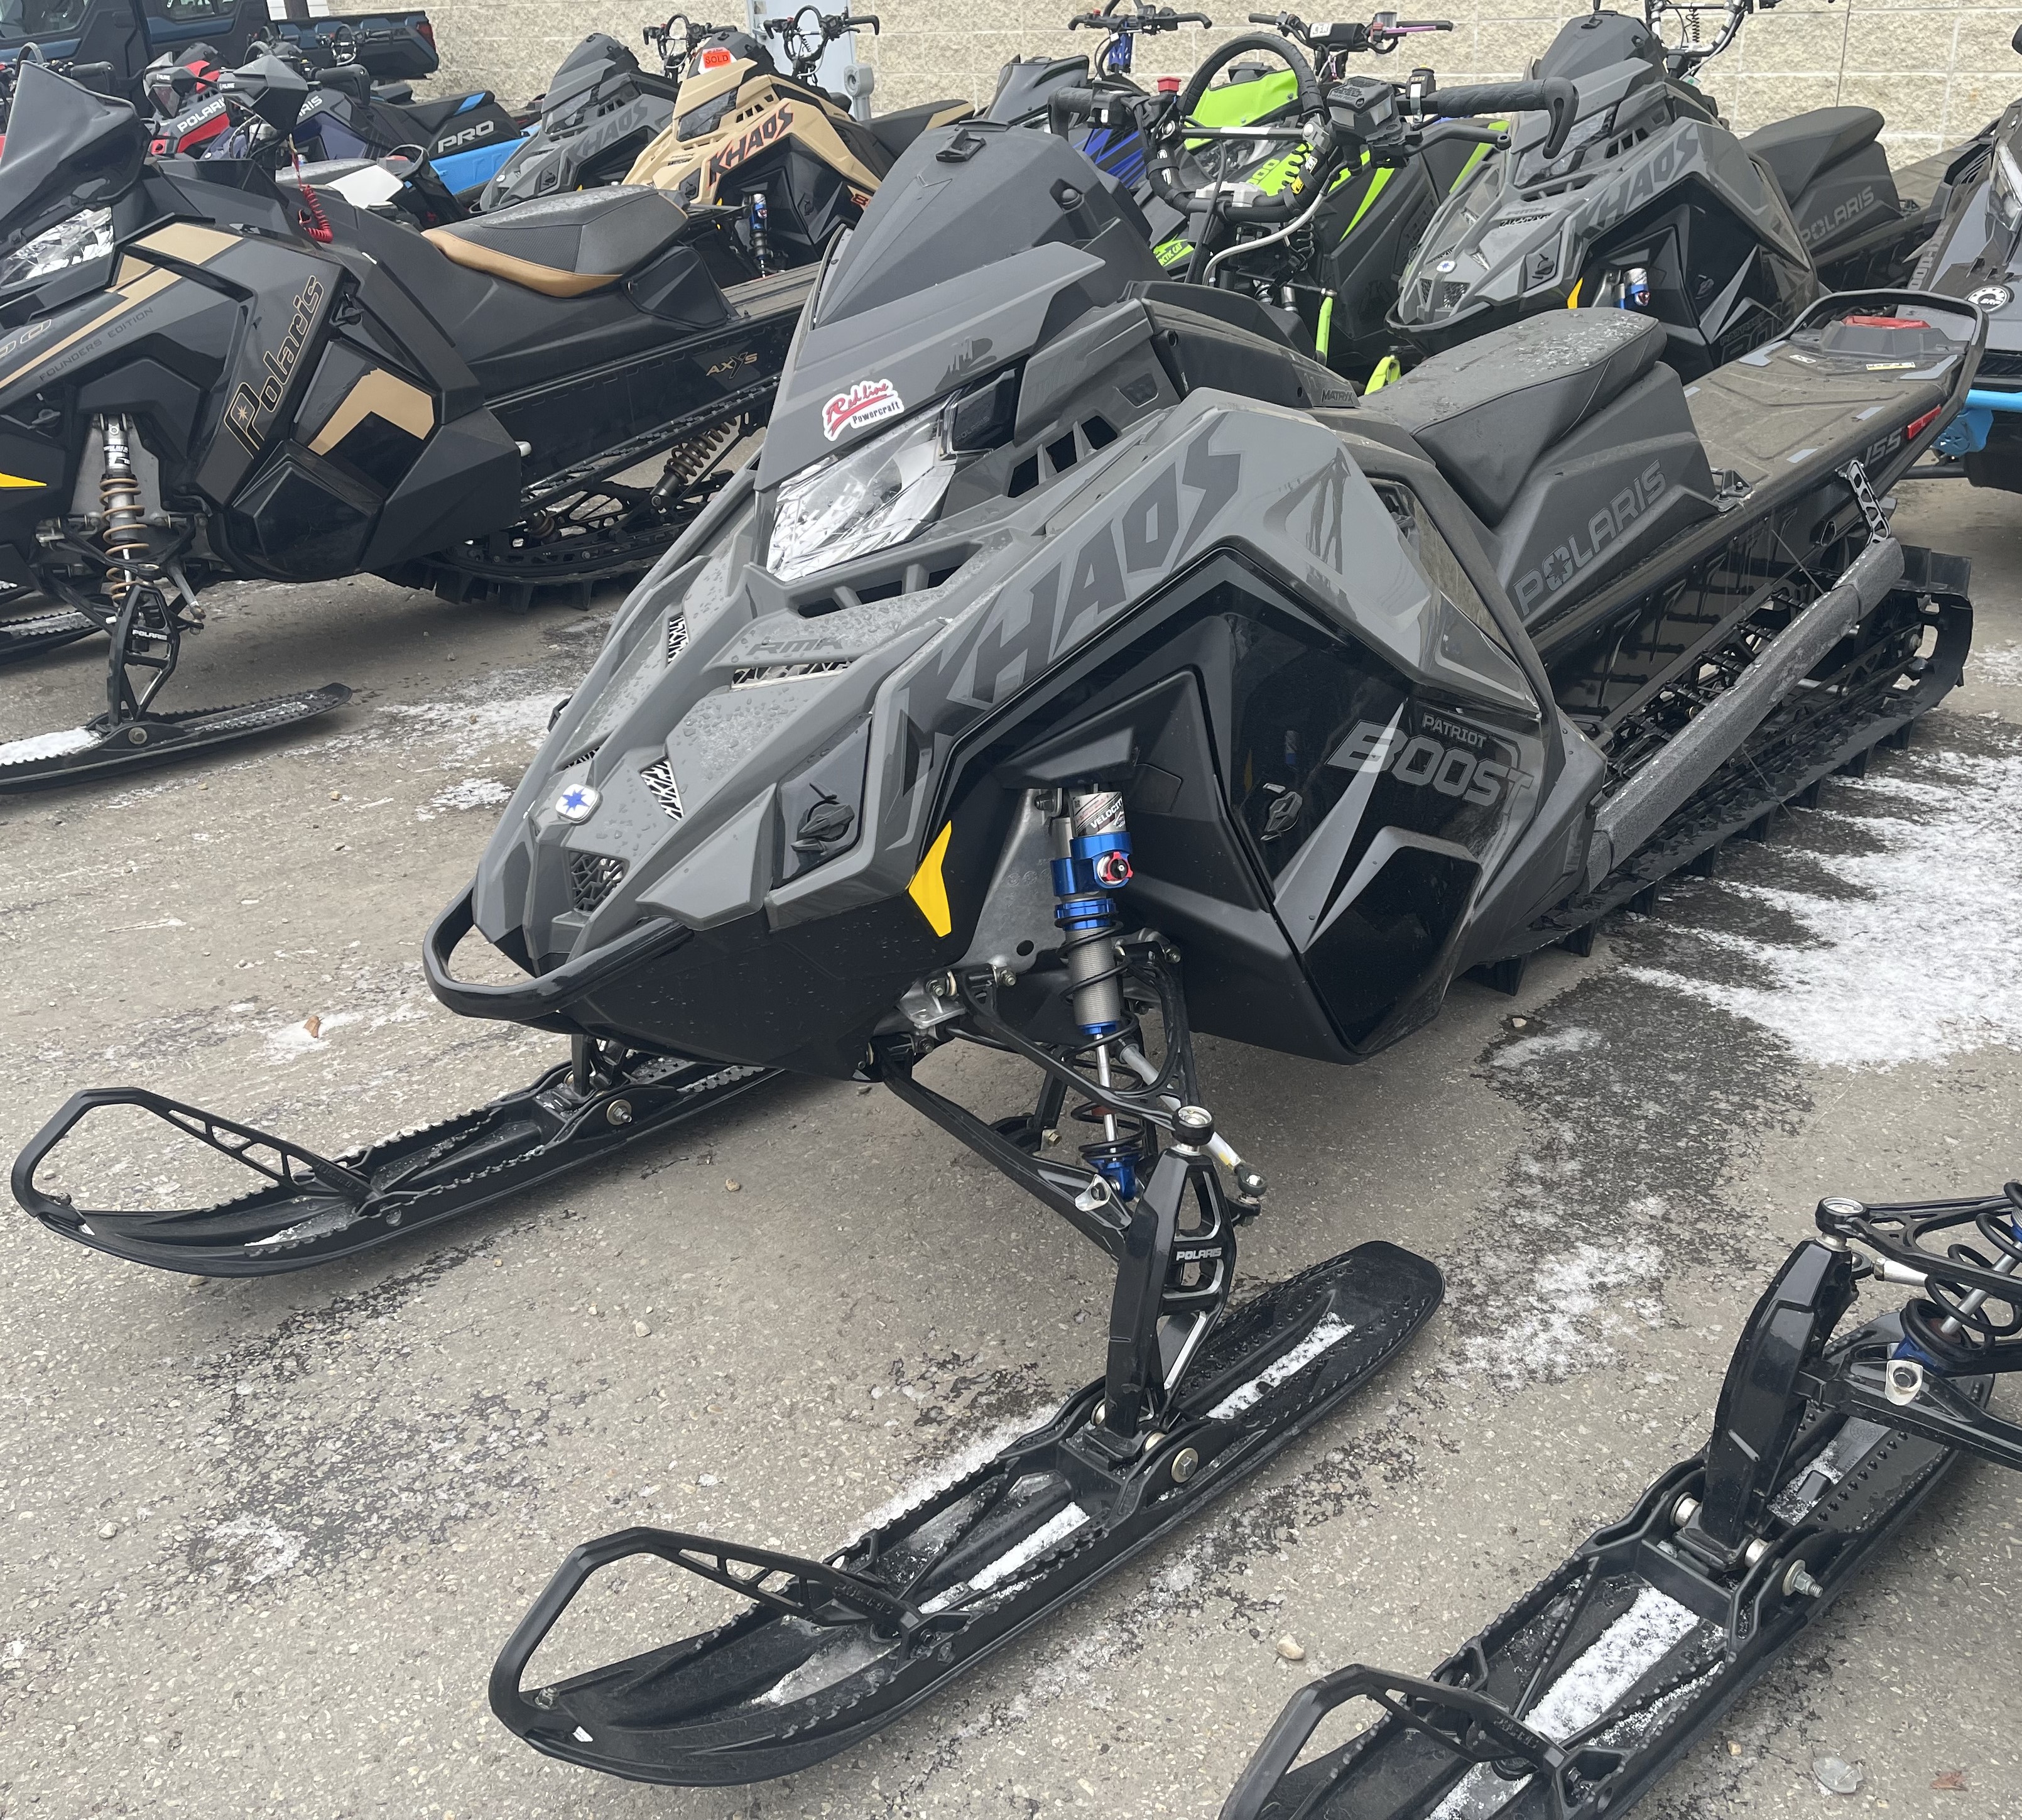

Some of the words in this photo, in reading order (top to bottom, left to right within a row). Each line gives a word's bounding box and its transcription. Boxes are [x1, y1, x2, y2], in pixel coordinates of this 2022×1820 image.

[705, 54, 729, 64] SOLD
[438, 120, 494, 154] PRO
[567, 101, 649, 175] KHAOS
[707, 102, 795, 188] KHAOS
[1570, 123, 1699, 261] KHAOS
[1799, 185, 1874, 246] POLARIS
[39, 338, 102, 381] FOUNDERS
[107, 307, 154, 339] EDITION
[224, 275, 324, 460] Polaris
[705, 352, 758, 379] AXYS
[852, 401, 901, 425] Powercraft
[1321, 388, 1354, 404] MATRYX
[954, 416, 991, 442] POLARIS
[1864, 427, 1903, 467] 155
[1513, 459, 1666, 617] POLARIS
[898, 411, 1244, 785] KHAOS
[132, 629, 168, 640] POLARIS
[1422, 712, 1487, 748] PATRIOT
[1324, 719, 1535, 819] BOOST
[1090, 796, 1123, 829] VELOCIT
[1176, 1247, 1222, 1261] POLARIS
